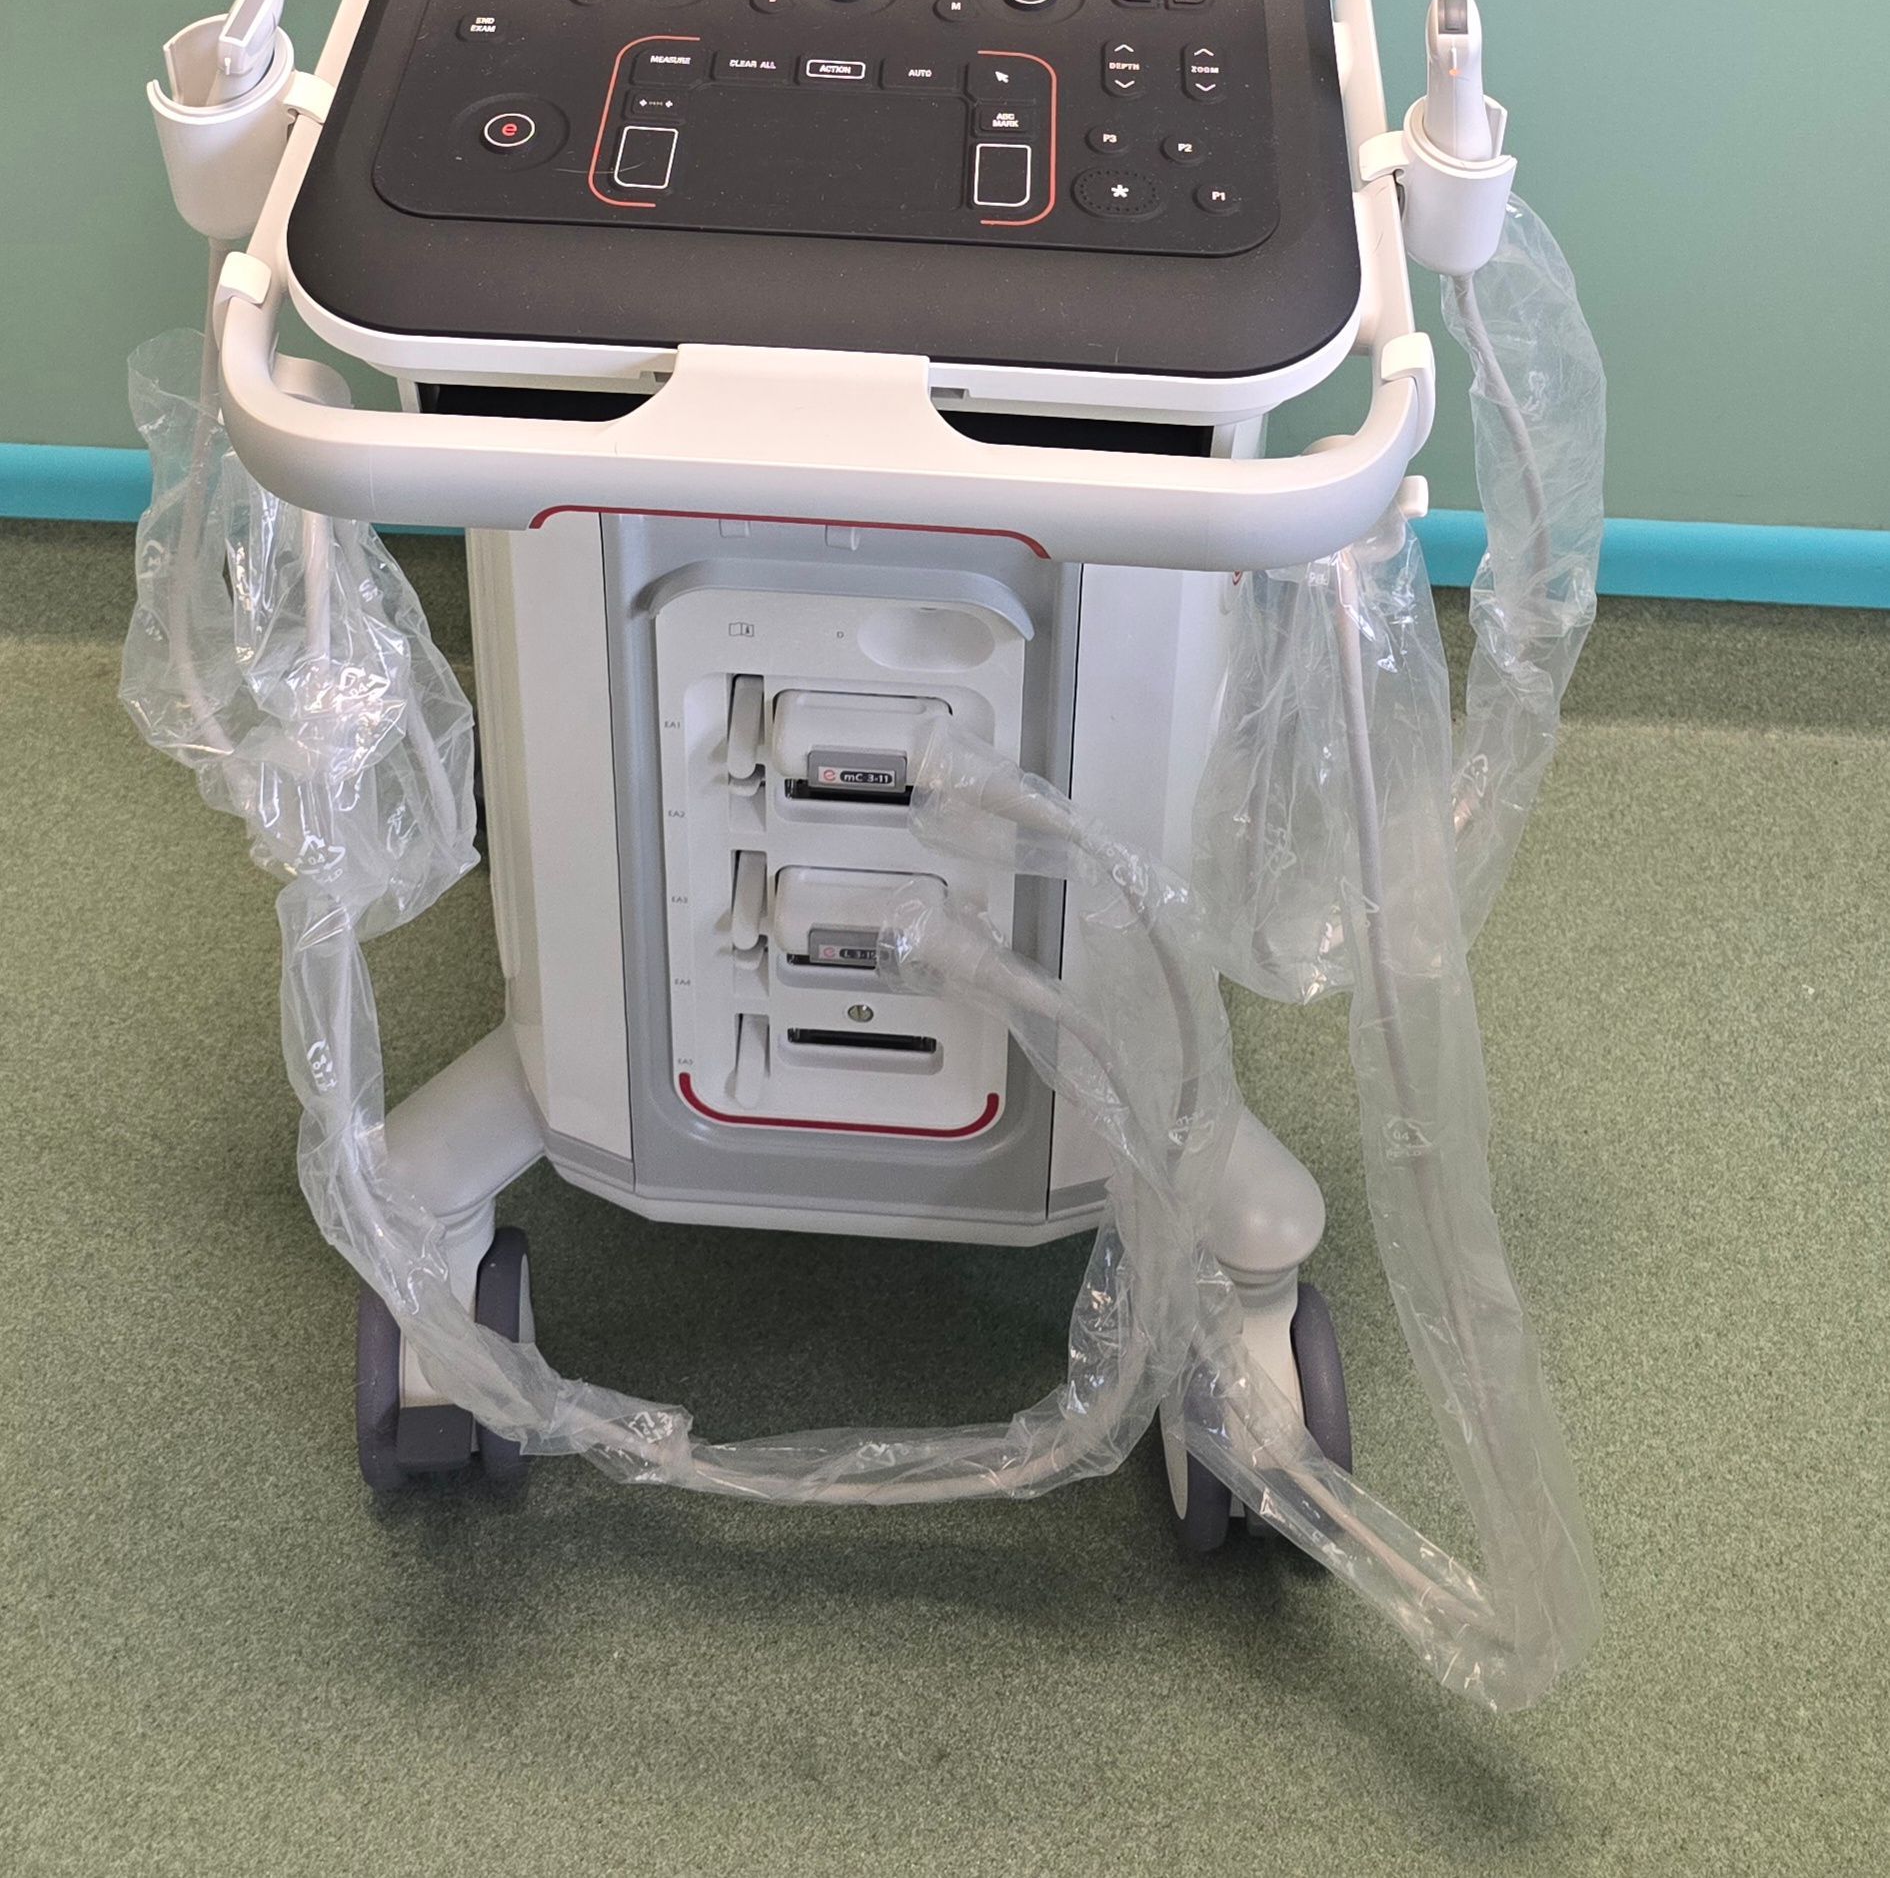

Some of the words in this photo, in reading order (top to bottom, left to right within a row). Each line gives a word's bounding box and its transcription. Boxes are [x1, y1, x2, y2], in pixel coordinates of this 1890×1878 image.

[951, 1, 961, 10] M
[470, 24, 496, 33] EXAM
[650, 55, 691, 65] MEASURE
[729, 59, 757, 69] CLEAR
[760, 61, 776, 69] ALL
[819, 64, 851, 74] ACTION
[1109, 62, 1140, 71] DEPTH
[1191, 65, 1219, 74] ZOOM
[908, 68, 932, 78] AUTO
[992, 119, 1019, 128] MARK
[1103, 133, 1117, 143] P3
[1178, 142, 1193, 153] P2
[1212, 191, 1226, 202] P1
[867, 774, 889, 784] 3-11
